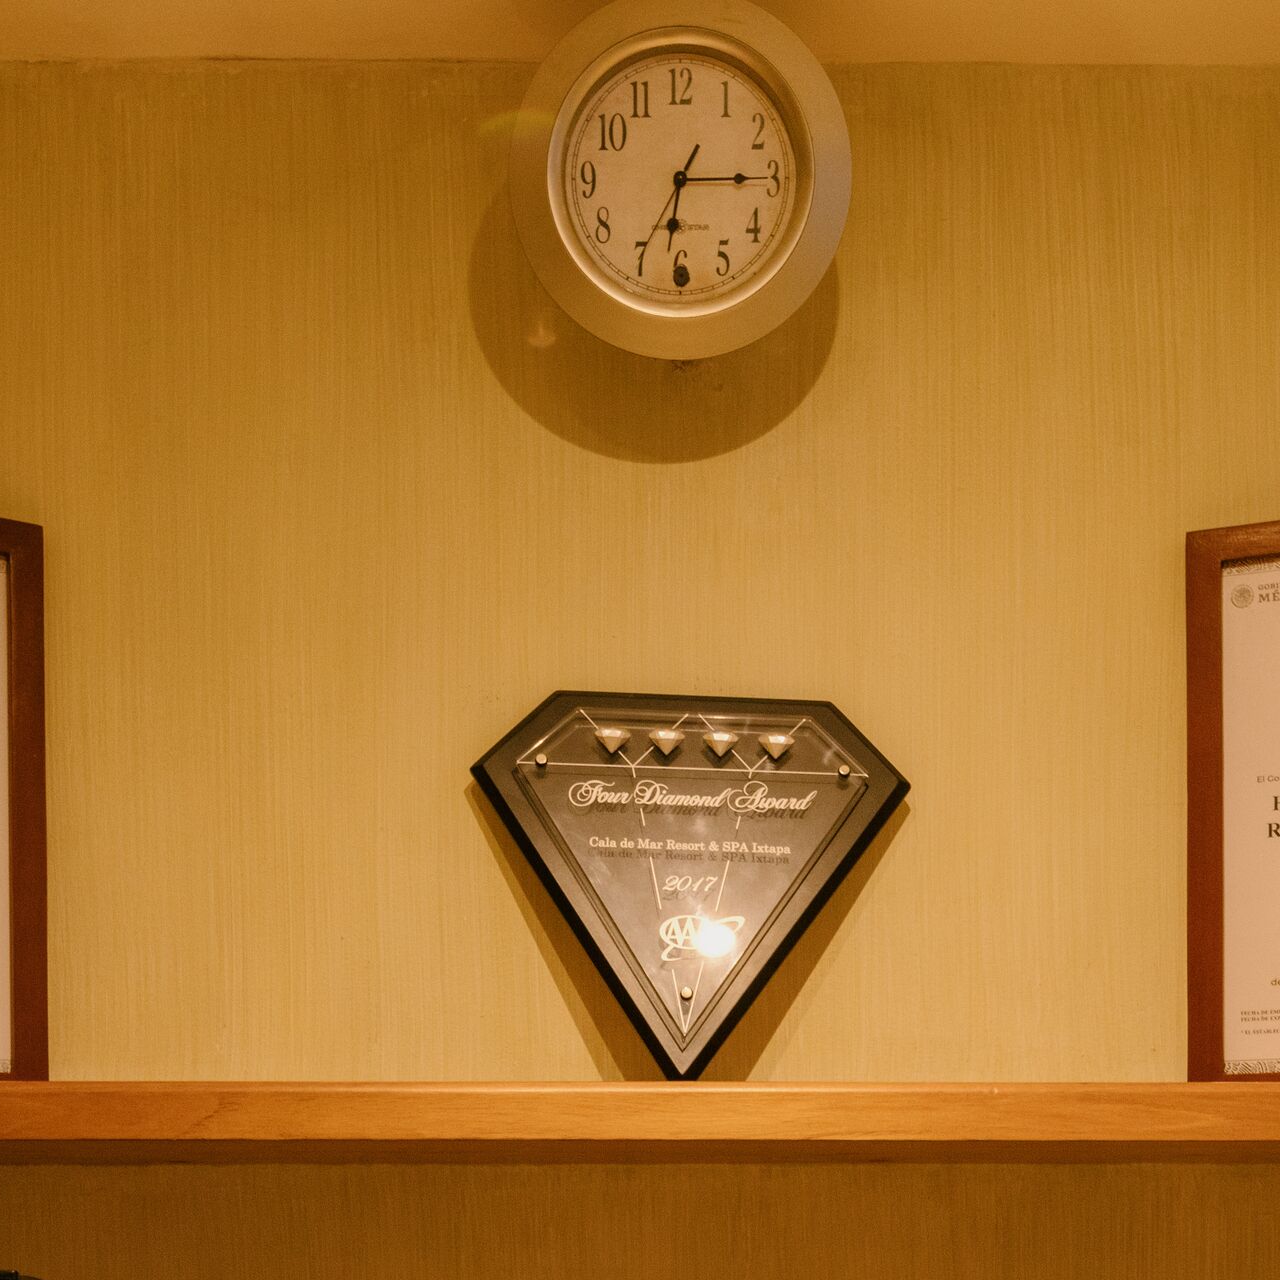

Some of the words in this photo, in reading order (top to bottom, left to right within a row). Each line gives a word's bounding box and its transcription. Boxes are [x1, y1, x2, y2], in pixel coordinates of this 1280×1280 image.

[630, 81, 651, 118] 11
[668, 68, 693, 105] 12
[720, 81, 731, 118] 1
[598, 112, 627, 151] 10
[752, 112, 765, 150] 2
[580, 160, 596, 198] 9
[767, 160, 780, 197] 3
[595, 206, 611, 243] 8
[746, 207, 761, 243] 4
[635, 241, 648, 277] 7
[716, 239, 730, 276] 5
[569, 779, 632, 808] Four
[633, 779, 730, 810] Diamond
[727, 780, 818, 816] Award
[589, 836, 617, 849] Cala
[620, 838, 634, 849] de
[637, 839, 663, 850] Mar
[666, 839, 705, 851] Resort
[709, 841, 719, 852] &
[722, 842, 749, 853] SPA
[752, 842, 791, 856] Ixtapa
[663, 875, 718, 893] 2017
